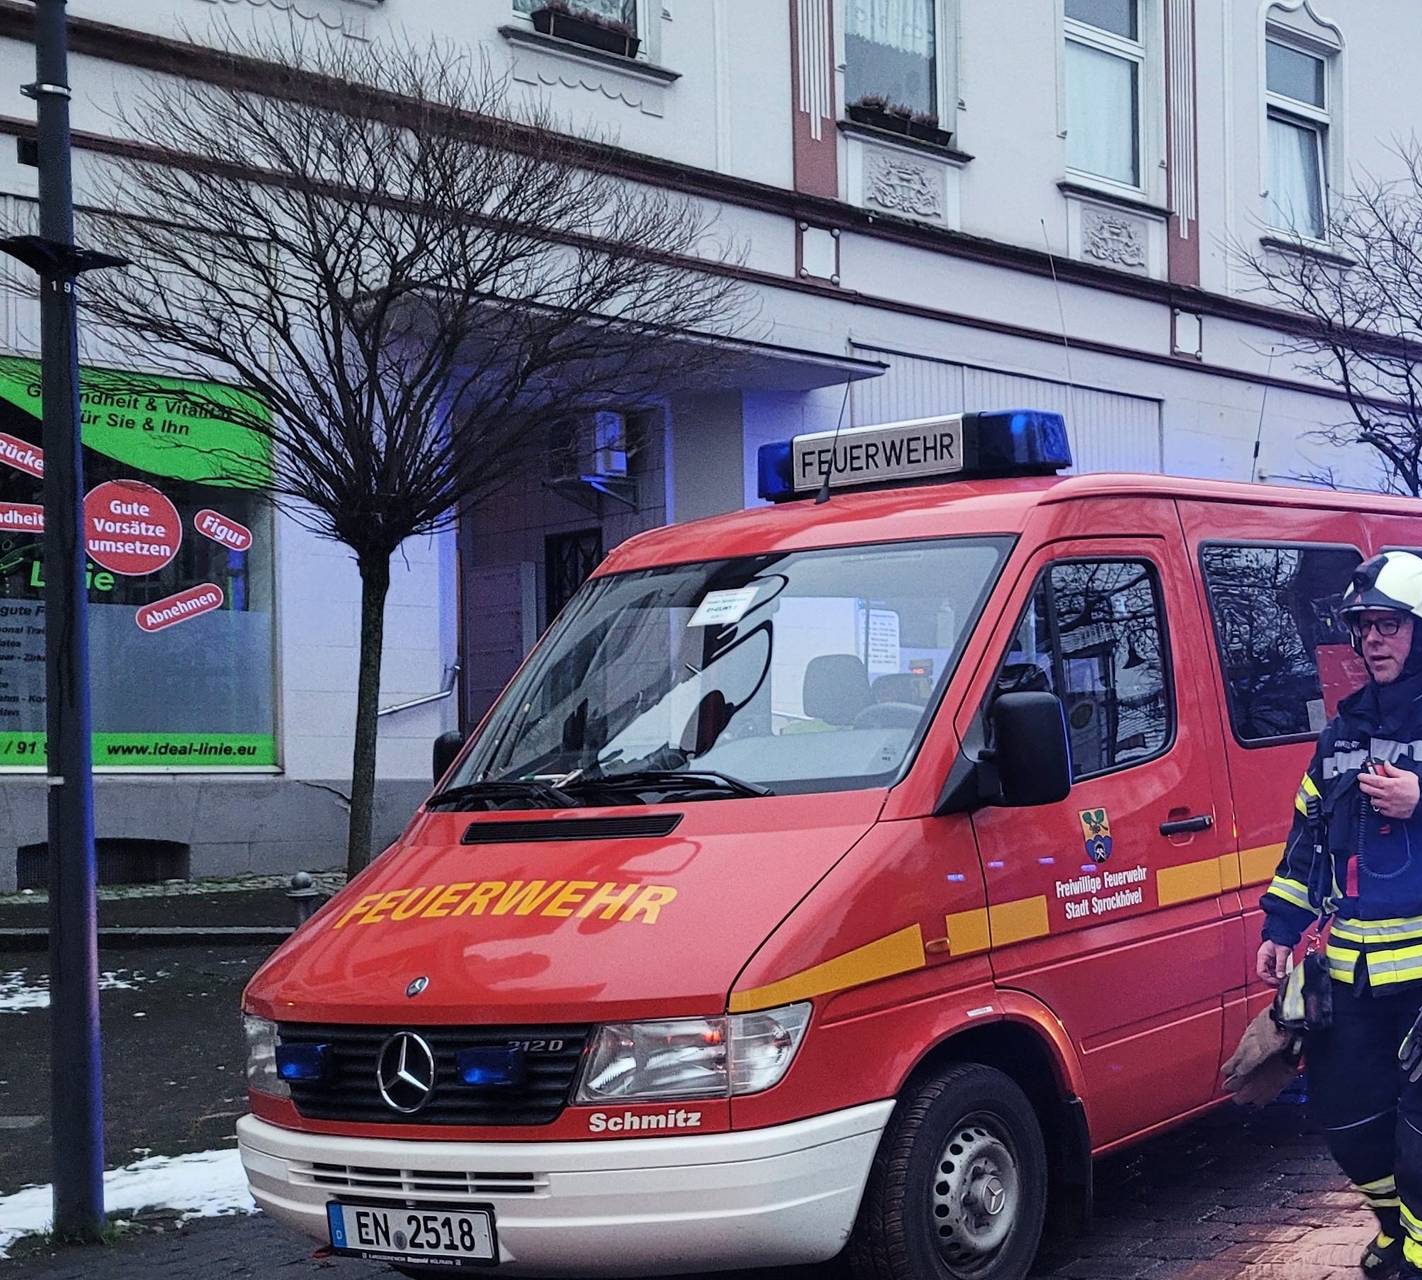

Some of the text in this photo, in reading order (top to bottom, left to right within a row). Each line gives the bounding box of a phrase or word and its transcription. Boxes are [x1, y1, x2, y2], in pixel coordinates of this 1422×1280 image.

[27, 383, 139, 410] Gndheit
[145, 397, 157, 411] &
[80, 411, 190, 436] ür Sie & Ihn
[0, 438, 44, 472] Rücke
[801, 432, 954, 478] FEUERWEHR
[110, 500, 150, 517] Gute
[93, 517, 166, 538] Vorsätze
[202, 514, 246, 546] Figur
[88, 538, 171, 557] umsetzen
[30, 560, 115, 592] Lie
[145, 591, 217, 627] Abnehmen
[107, 742, 257, 756] www.ideal-linie.eu
[1055, 865, 1148, 899] Freiwillige Feuerwehr
[333, 880, 678, 929] FEUERWEHR
[1065, 887, 1143, 920] Stadt Sprockhövel
[548, 1040, 564, 1052] D
[589, 1109, 702, 1132] Schmitz
[356, 1211, 476, 1252] EN 2518
